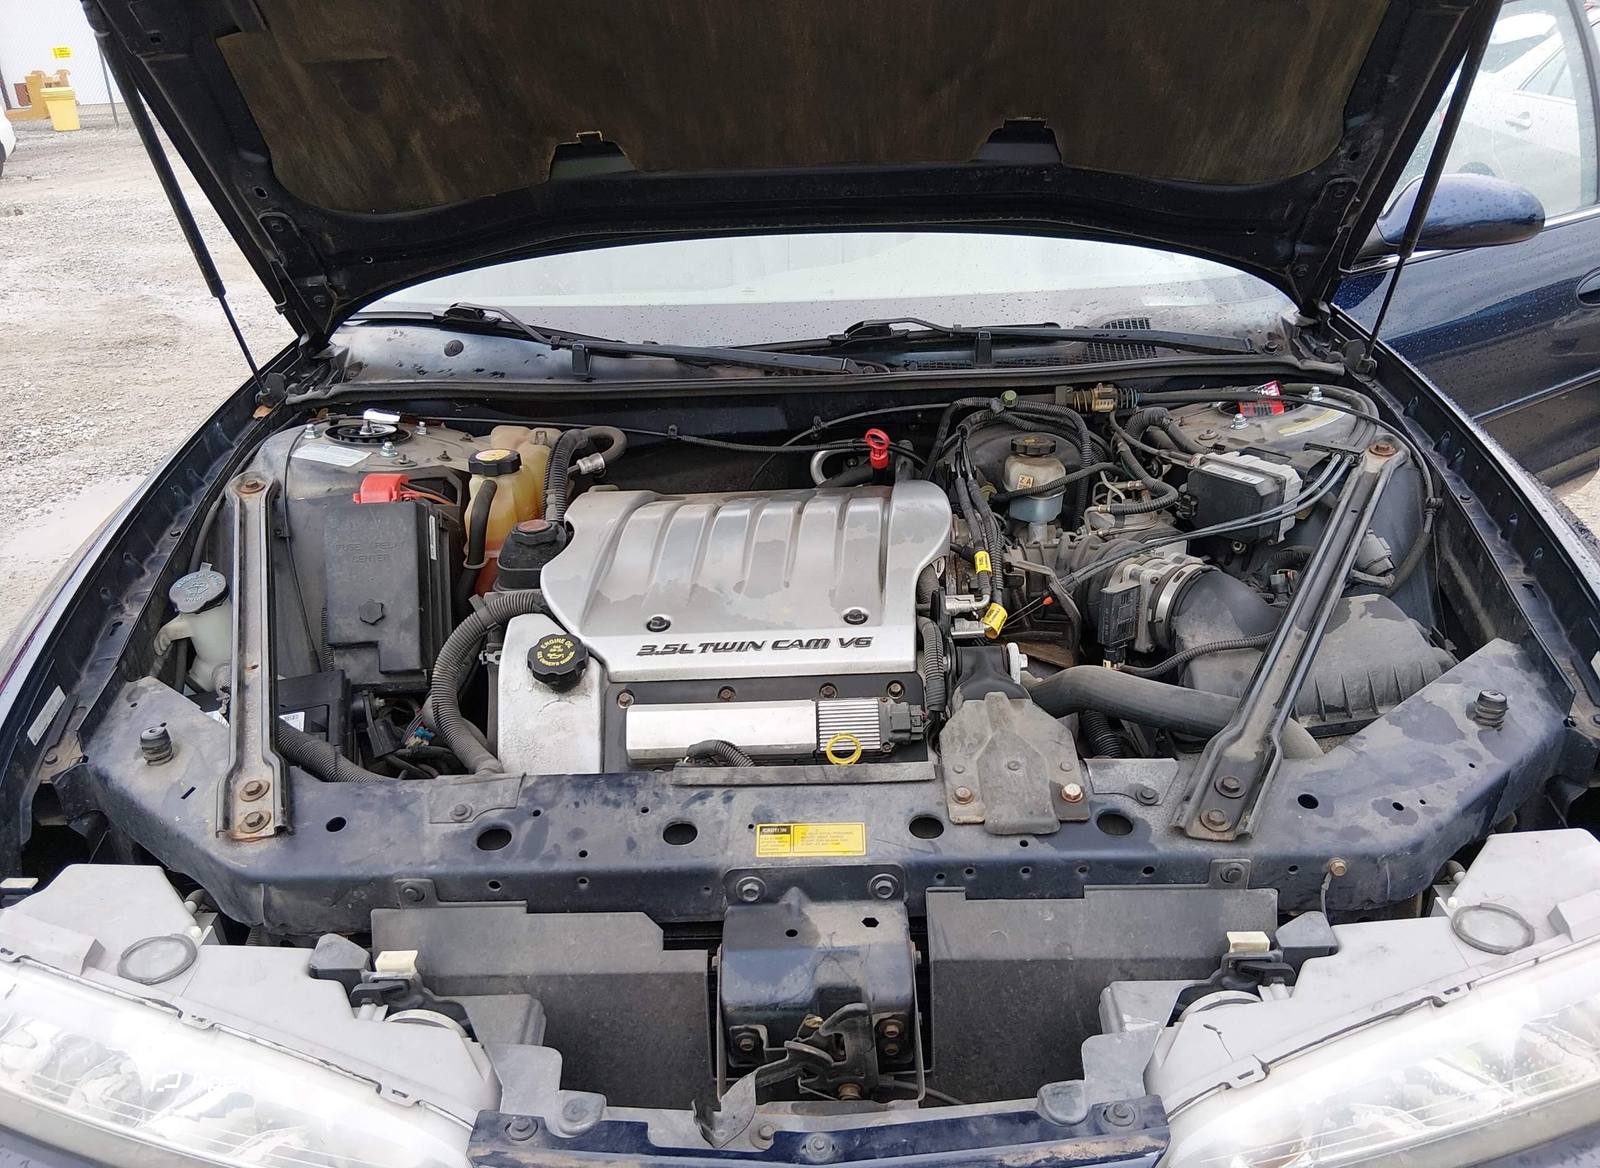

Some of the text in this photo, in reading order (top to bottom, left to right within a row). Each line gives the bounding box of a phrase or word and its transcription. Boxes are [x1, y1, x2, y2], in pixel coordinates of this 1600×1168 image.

[335, 540, 405, 552] FUSE RELAY
[353, 554, 391, 563] CENTER
[540, 638, 567, 649] ENGINE
[636, 636, 874, 656] 3.5L TWIN CAM V6
